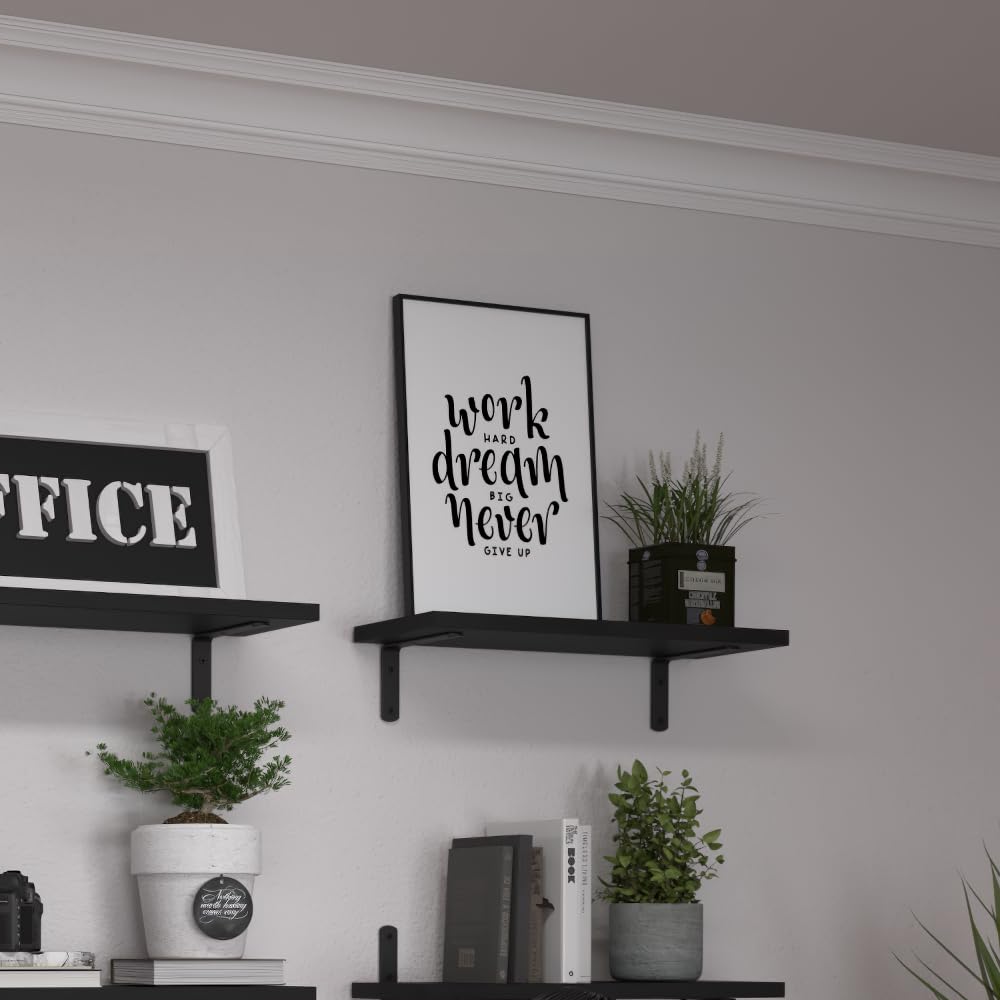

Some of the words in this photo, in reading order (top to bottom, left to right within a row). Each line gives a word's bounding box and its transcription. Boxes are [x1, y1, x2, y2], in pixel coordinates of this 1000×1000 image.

[444, 375, 550, 439] work
[484, 433, 516, 445] HARD
[432, 429, 568, 502] dream
[489, 491, 514, 502] BIG
[484, 546, 512, 557] GIVE
[518, 547, 531, 557] UP
[567, 848, 576, 883] BOOK
